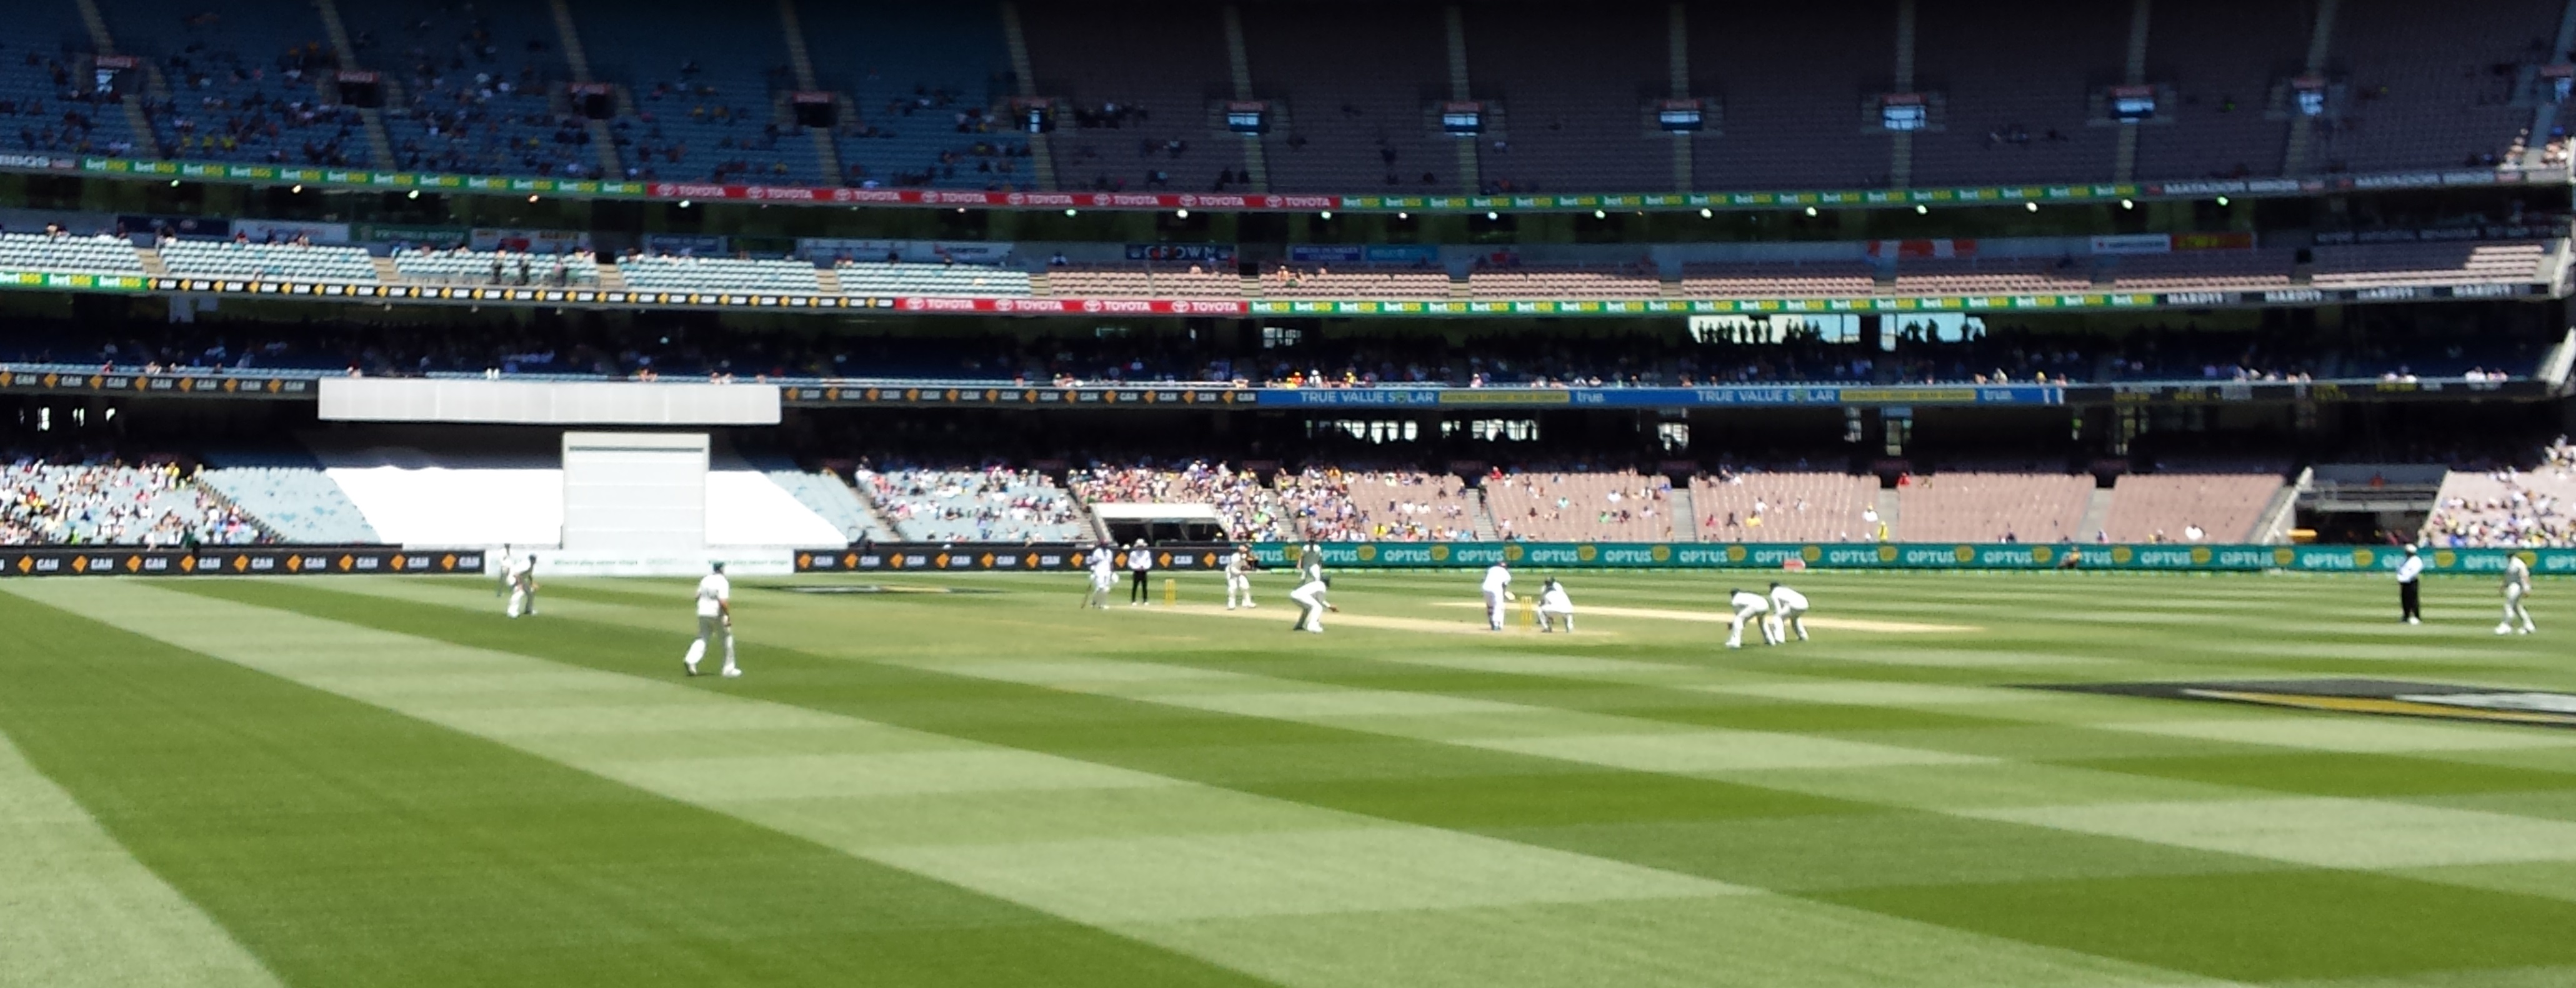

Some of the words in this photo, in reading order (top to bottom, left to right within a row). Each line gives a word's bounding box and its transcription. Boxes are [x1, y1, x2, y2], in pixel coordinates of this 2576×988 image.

[678, 186, 725, 196] TOYOTA
[767, 189, 813, 199] TOYOTA
[855, 190, 901, 200] TOYOTA
[942, 192, 987, 203] TOYOTA
[1027, 194, 1073, 204] TOYOTA
[1114, 196, 1160, 205] TOYOTA
[1199, 196, 1245, 206] TOYOTA
[1285, 197, 1330, 206] TOYOTA
[1144, 246, 1215, 260] CROWN
[49, 274, 92, 286] bet365
[99, 276, 141, 287] bet365
[926, 299, 974, 310] TOYOTA
[1015, 301, 1063, 311] TOYOTA
[1103, 301, 1151, 311] TOYOTA
[1192, 302, 1238, 311] TOYOTA
[1253, 302, 1290, 311] bet365
[1295, 302, 1333, 311] bet365
[1339, 302, 1377, 311] bet365
[1384, 302, 1422, 311] bet365
[1429, 301, 1466, 311] bet365
[1471, 301, 1509, 311] bet365
[1515, 301, 1554, 311] bet365
[1562, 301, 1600, 311] bet365
[1606, 301, 1644, 311] bet365
[1650, 301, 1687, 311] bet365
[1695, 301, 1732, 311] bet365
[1741, 301, 1779, 311] bet365
[1787, 300, 1824, 310] bet365
[1830, 299, 1869, 309] bet365
[1877, 299, 1915, 308] bet365
[1922, 297, 1961, 307] bet365
[1969, 297, 2008, 306] bet365
[2015, 296, 2055, 306] bet365
[2064, 295, 2104, 305] bet365
[2112, 294, 2152, 304] bet365
[1300, 392, 1337, 402] TRUE
[1340, 392, 1384, 402] VALUE
[1697, 390, 1734, 401] TRUE
[1739, 390, 1784, 401] VALUE
[37, 559, 58, 570] CAN
[91, 559, 114, 569] CAN
[145, 558, 167, 569] CAN
[199, 557, 221, 569] CAN
[252, 557, 274, 569] CAN
[304, 557, 326, 569] CAN
[357, 557, 378, 568] CAN
[408, 557, 429, 568] CAN
[459, 557, 480, 568] CAN
[1320, 550, 1357, 561] PTUS
[1384, 551, 1430, 561] OPTUS
[1457, 550, 1504, 562] OPTUS
[1532, 551, 1578, 562] OPTUS
[1605, 551, 1652, 562] OPTUS
[1679, 551, 1727, 562] OPTUS
[1830, 551, 1879, 562] OPTUS
[1907, 551, 1955, 563] OPTUS
[1984, 551, 2032, 563] OPTUS
[2140, 552, 2192, 564] OPTUS
[2220, 552, 2274, 564] OPTUS
[2303, 552, 2354, 566] OPTUS
